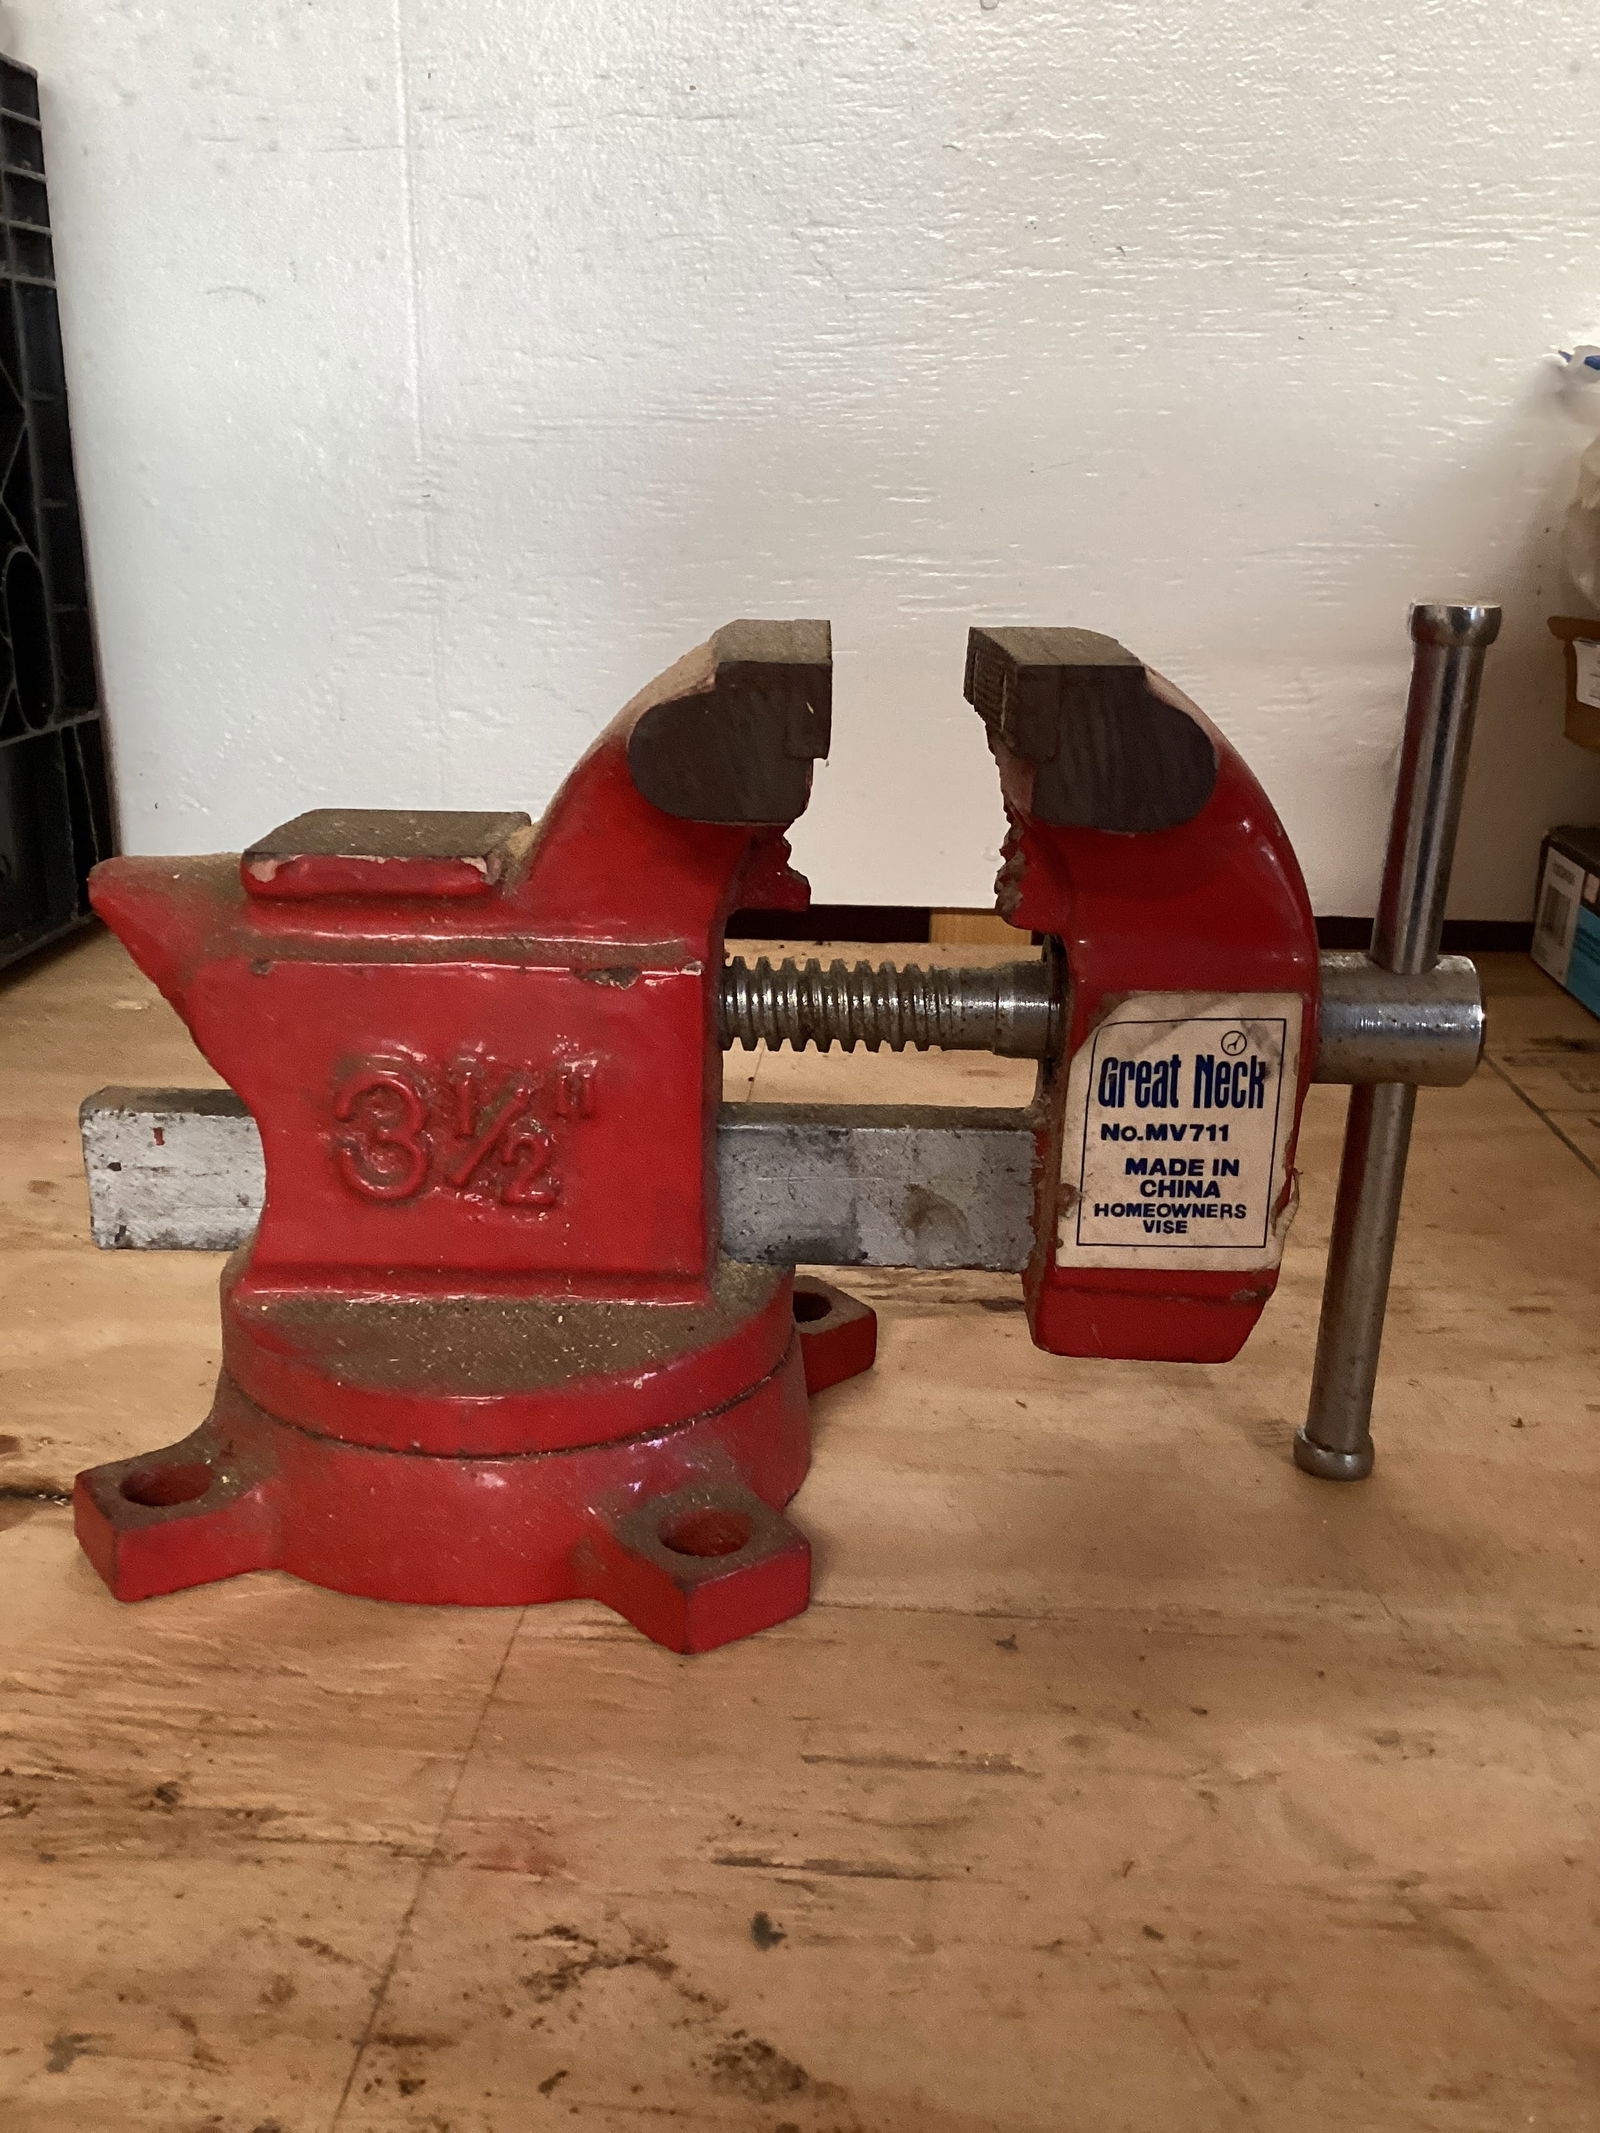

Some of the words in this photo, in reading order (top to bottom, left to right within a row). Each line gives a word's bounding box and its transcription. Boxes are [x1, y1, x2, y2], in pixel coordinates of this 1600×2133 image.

[1098, 1054, 1181, 1108] Great
[1192, 1054, 1266, 1108] Neck
[1101, 1124, 1230, 1142] No.MV711
[1125, 1158, 1204, 1176] MADE
[1212, 1158, 1240, 1177] IN
[1140, 1180, 1221, 1199] CHINA
[1094, 1203, 1247, 1219] HOMEOWNERS
[1143, 1220, 1188, 1233] VISE
